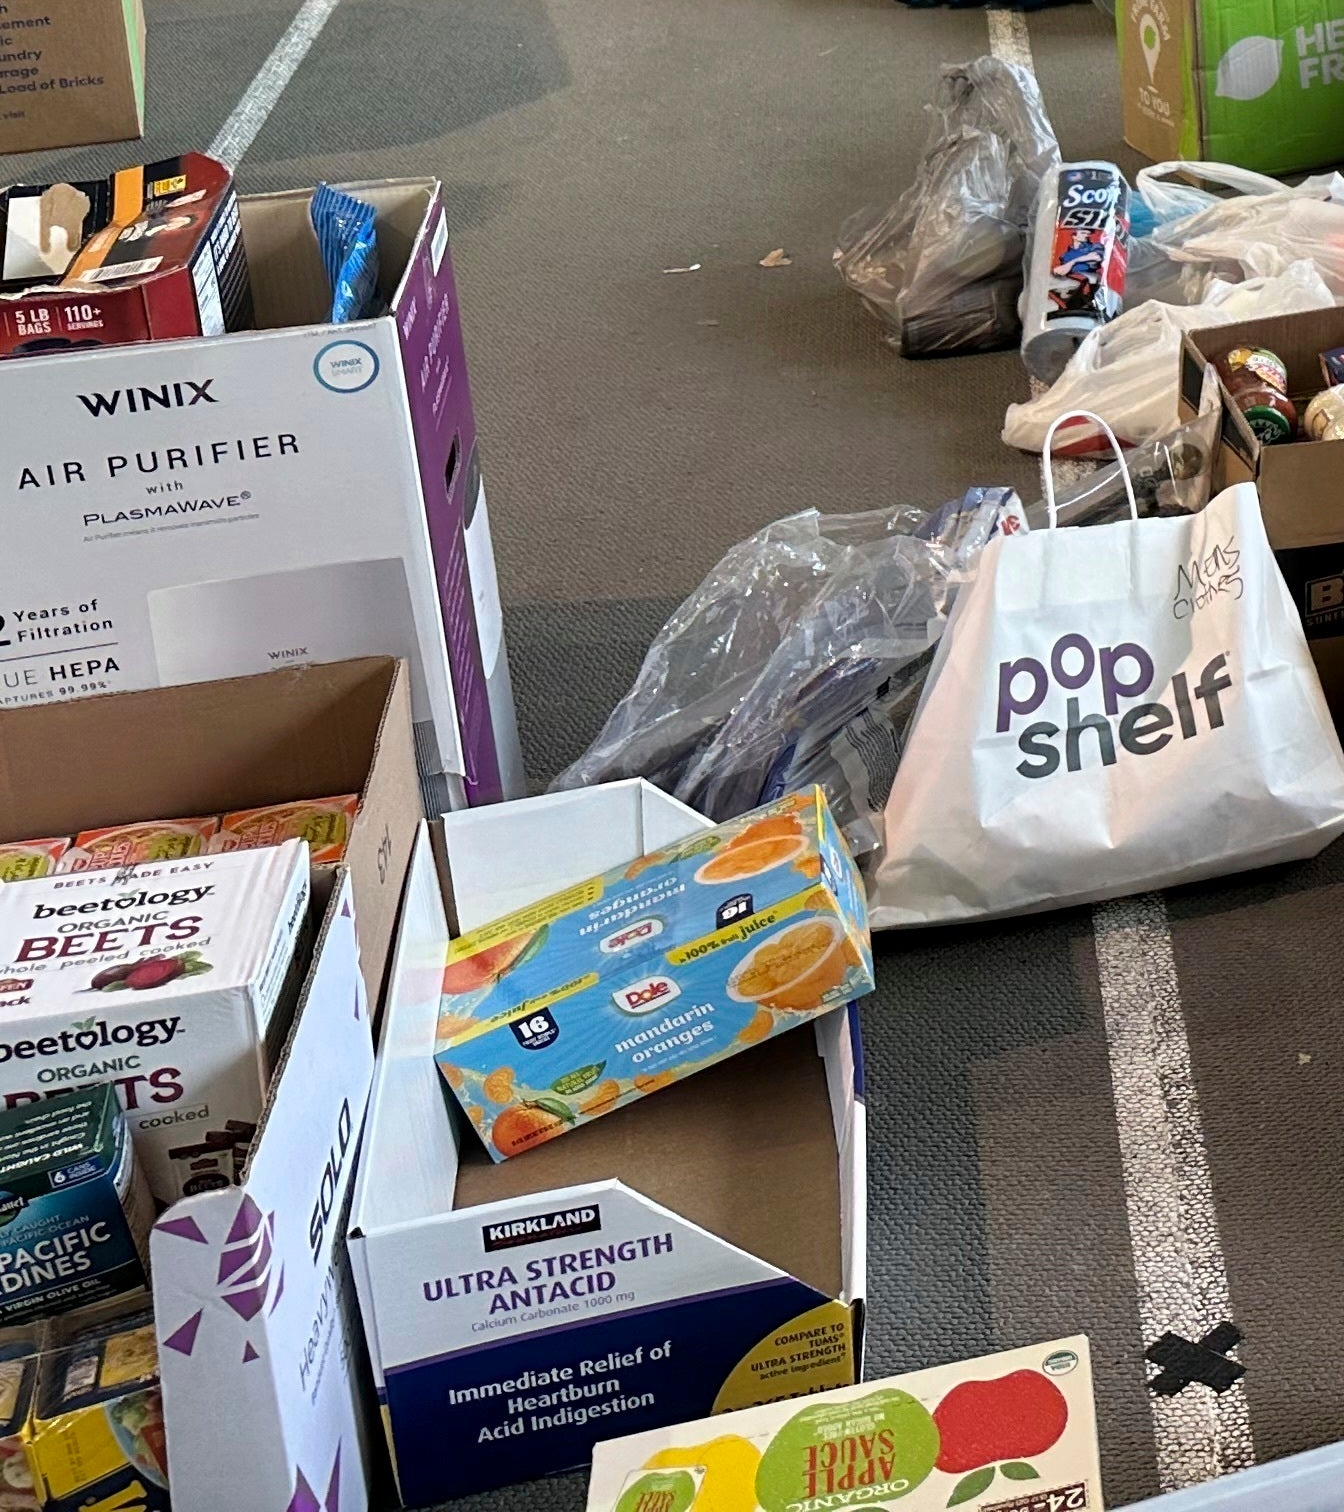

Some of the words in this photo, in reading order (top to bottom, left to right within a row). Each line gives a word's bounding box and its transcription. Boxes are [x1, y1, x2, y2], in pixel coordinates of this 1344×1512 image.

[40, 78, 56, 92] of
[59, 76, 104, 89] Bricks
[18, 322, 51, 336] BAGS
[64, 303, 101, 323] 110+
[76, 378, 220, 418] WINIX
[19, 460, 87, 490] AIR
[107, 433, 301, 478] PURIFIER
[146, 480, 185, 496] with
[13, 603, 71, 623] Years
[79, 598, 99, 614] of
[17, 617, 114, 644] Filtration
[49, 656, 121, 682] HEPA
[267, 646, 309, 662] WINIX
[997, 632, 1155, 733] pop
[1015, 652, 1232, 781] shelf
[54, 876, 107, 890] BEETS
[170, 861, 215, 875] EASY
[33, 884, 215, 920] beetology
[15, 915, 204, 963] BEETS
[57, 910, 170, 934] ORGANIC
[738, 913, 778, 941] juice
[60, 950, 131, 970] peeled
[138, 936, 213, 957] cooked
[624, 979, 669, 1009] Dole
[516, 1015, 550, 1040] 16
[613, 1000, 716, 1055] mandarin
[631, 1019, 715, 1066] oranges
[37, 1055, 141, 1084] ORGANIC
[138, 1104, 210, 1130] cooked
[309, 1097, 351, 1267] SOLO
[488, 1208, 596, 1242] KIRKLAND
[422, 1258, 519, 1303] ULTRA
[525, 1232, 674, 1281] STRENGTH
[488, 1270, 617, 1315] ANTACID
[470, 1312, 518, 1334] Calcium
[519, 1301, 580, 1324] Carbonate
[583, 1293, 614, 1310] 1000
[773, 1325, 827, 1347] COMPARE
[828, 1322, 846, 1337] TO
[448, 1364, 575, 1406] Immediate
[579, 1346, 643, 1378] Relief
[649, 1340, 673, 1360] of
[750, 1355, 787, 1374] ULTRA
[787, 1342, 847, 1367] STRENGTH
[507, 1376, 622, 1416] Heartburn
[476, 1417, 527, 1444] Acid
[530, 1391, 656, 1432] Indigestion
[802, 1428, 896, 1468] SAUCE
[802, 1452, 896, 1499] APPLE
[784, 1477, 910, 1512] ORGANIC
